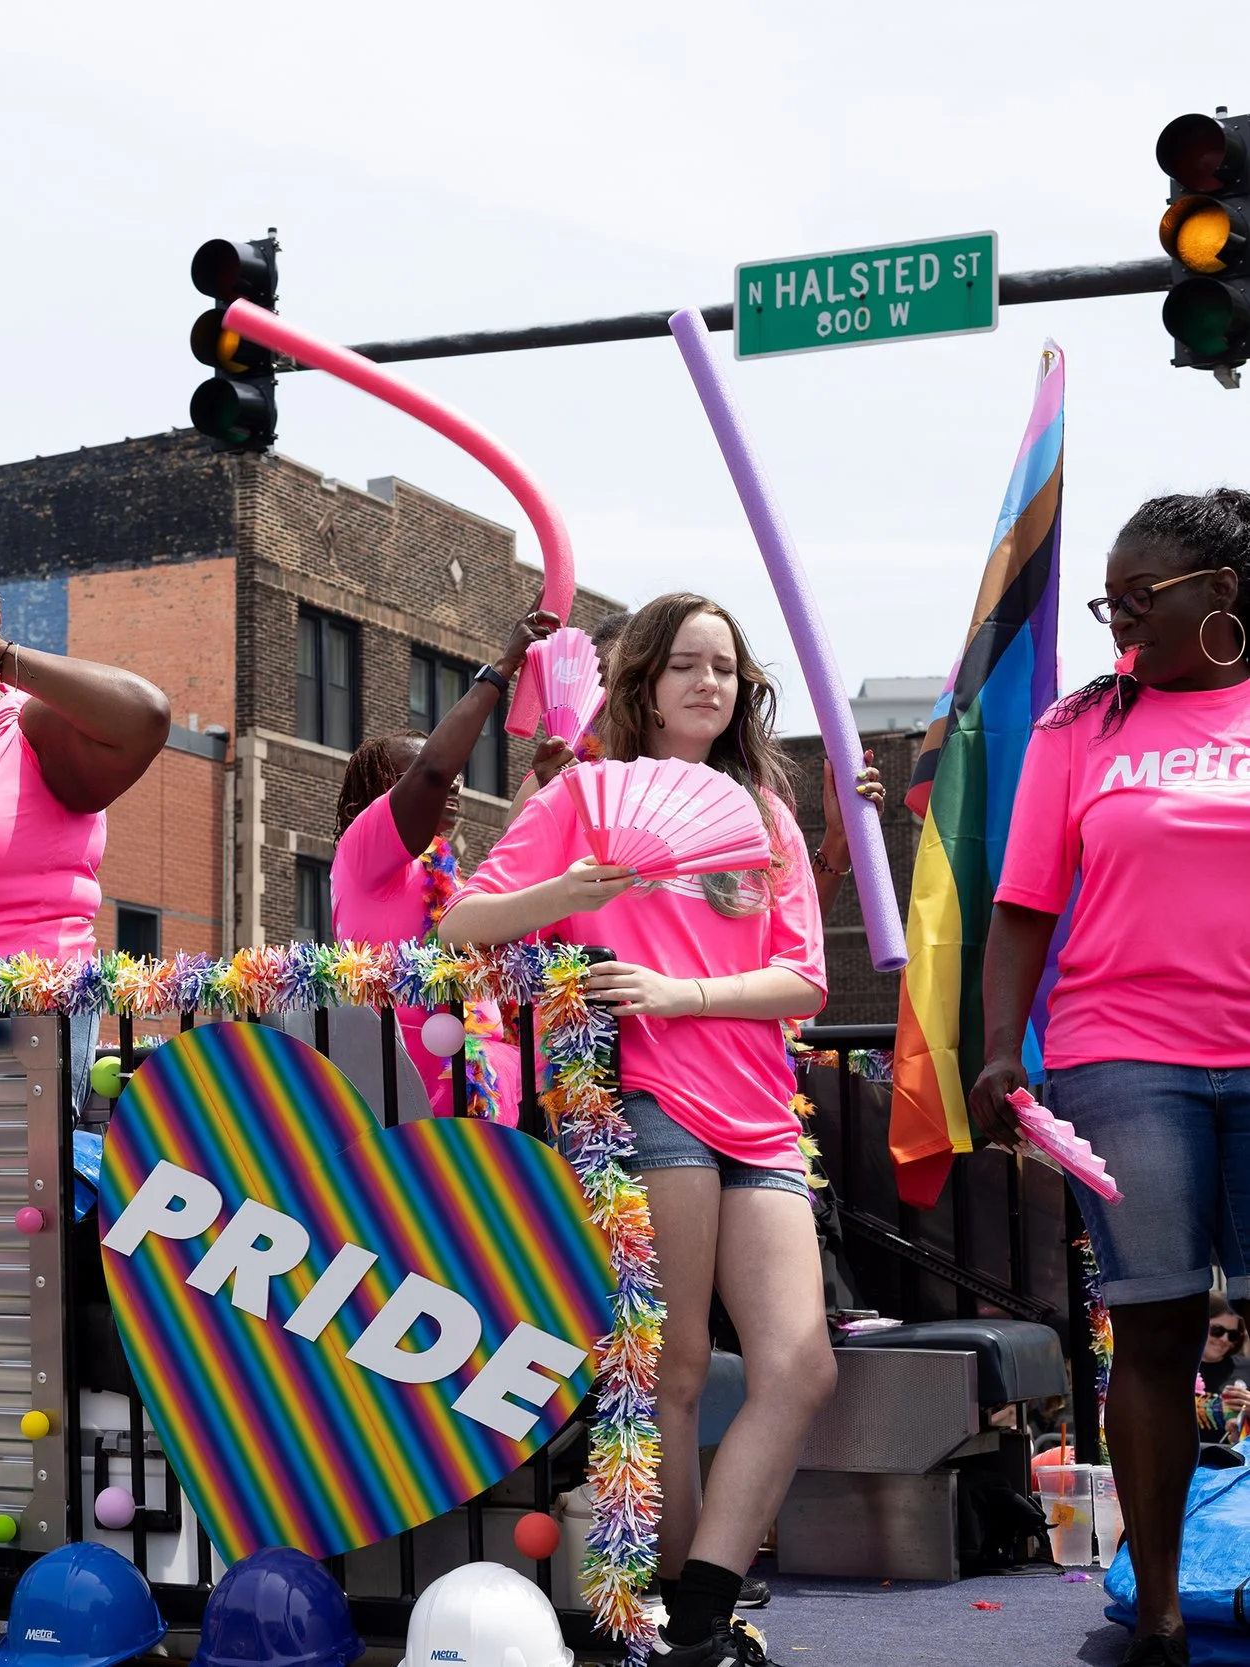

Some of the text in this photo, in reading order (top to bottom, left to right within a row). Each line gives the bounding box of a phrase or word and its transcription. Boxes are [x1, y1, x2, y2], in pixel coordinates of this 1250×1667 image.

[749, 252, 981, 308] N HALSTED ST
[816, 302, 910, 337] 800 W
[101, 1159, 589, 1443] PRIDE
[25, 1628, 54, 1641] Metra
[430, 1650, 459, 1661] Metra
